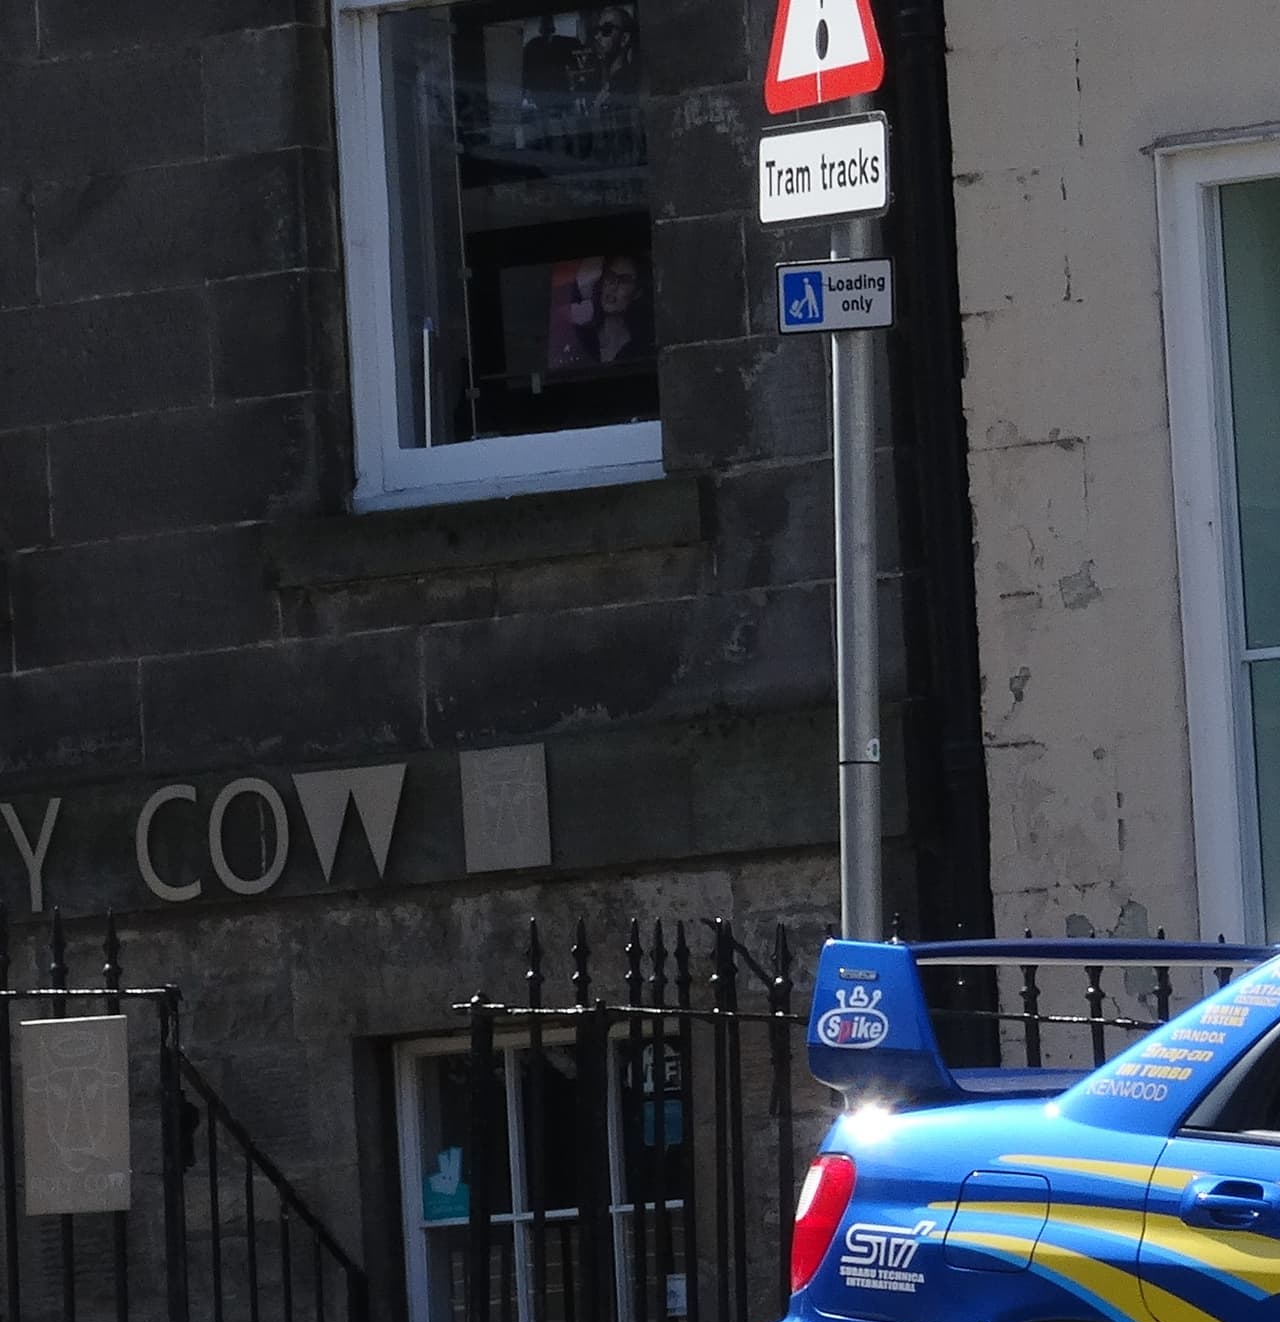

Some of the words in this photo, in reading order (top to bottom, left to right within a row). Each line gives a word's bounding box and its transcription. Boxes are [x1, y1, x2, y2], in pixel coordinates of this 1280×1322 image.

[765, 160, 811, 197] Tram
[820, 148, 880, 190] tracks
[828, 274, 886, 294] Loading
[842, 295, 873, 314] only
[136, 763, 408, 902] COW
[826, 1015, 883, 1044] Spike
[1171, 1028, 1227, 1044] STANDOX
[1142, 1043, 1214, 1063] Snap-on
[1140, 1065, 1193, 1081] TURBO
[1086, 1079, 1168, 1102] KENWOOD
[839, 1266, 877, 1279] SUBARU
[846, 1276, 916, 1293] INTERNATIONAL
